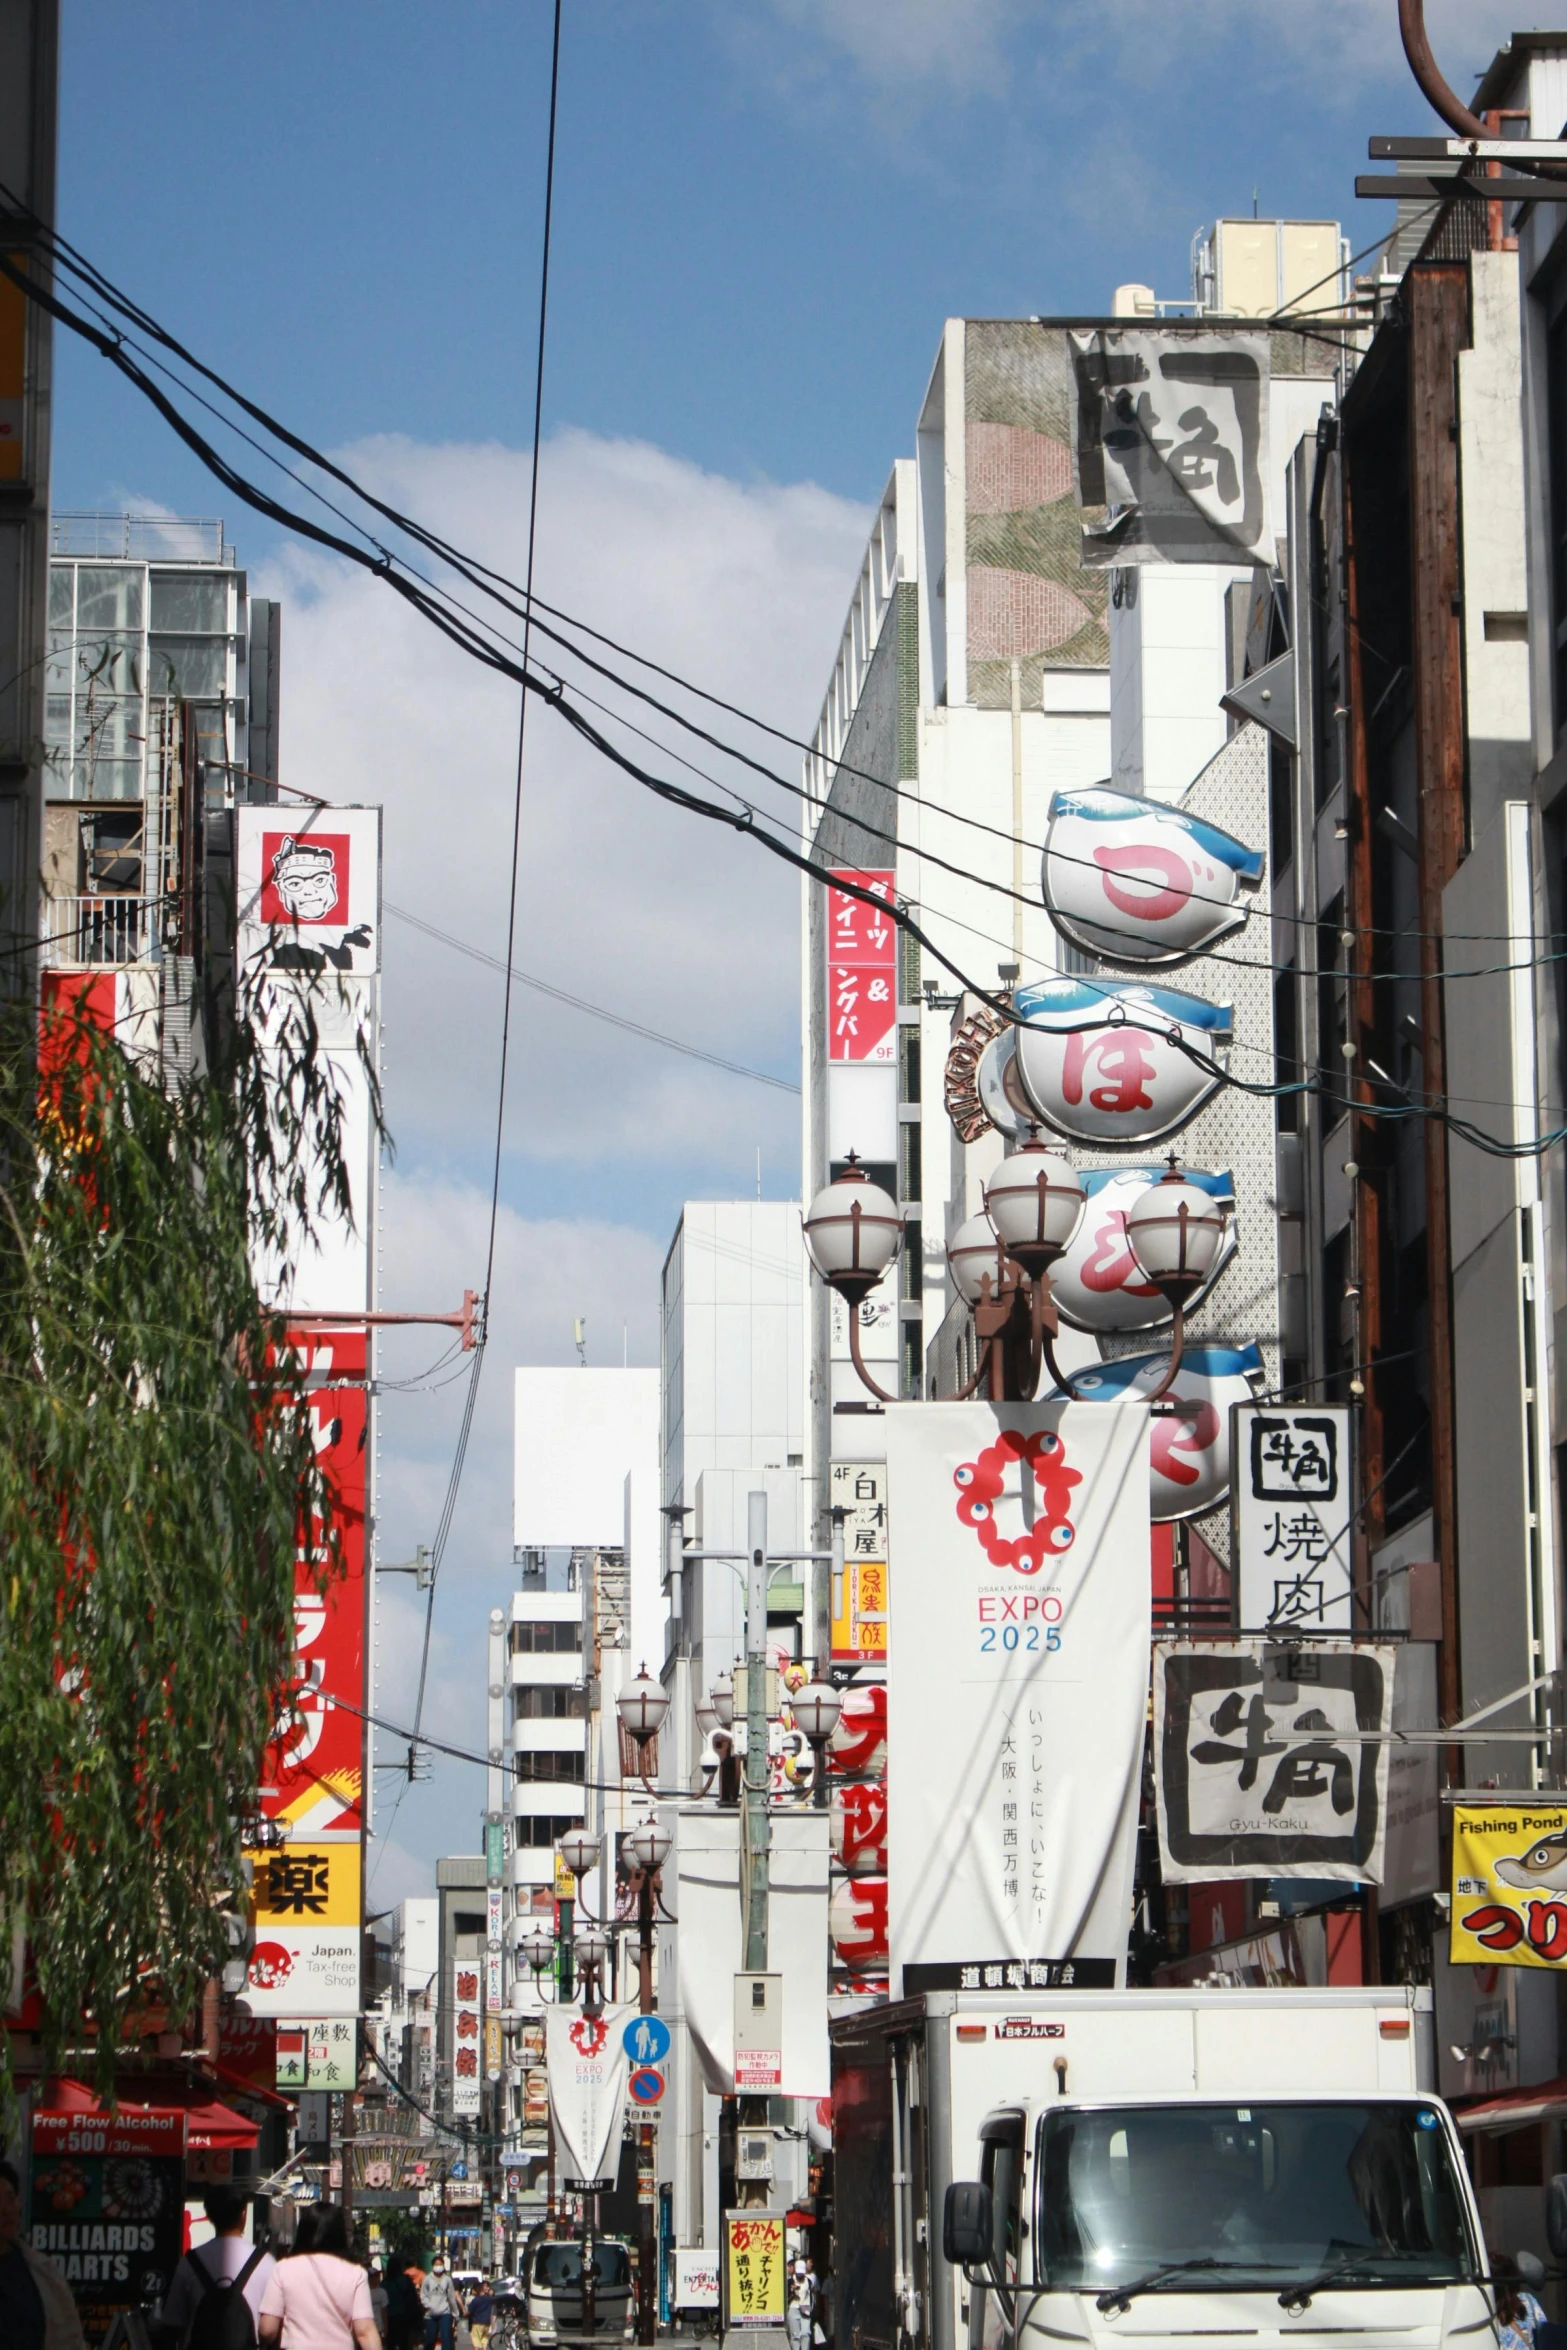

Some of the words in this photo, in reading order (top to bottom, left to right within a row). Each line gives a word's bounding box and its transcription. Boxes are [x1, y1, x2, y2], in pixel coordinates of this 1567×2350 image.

[867, 978, 890, 1002] &
[876, 1047, 894, 1059] 9F
[1263, 1432, 1329, 1483] 牛角
[833, 1467, 850, 1481] 4F
[1264, 1511, 1328, 1623] 焼肉
[978, 1595, 1063, 1623] EXPO
[980, 1625, 1062, 1652] 2025
[857, 1651, 875, 1660] 3F
[1190, 1691, 1355, 1817] 牛角
[1229, 1817, 1309, 1833] Gyu-Kaku
[1459, 1818, 1518, 1835] Fishing
[1522, 1816, 1563, 1830] Pond
[268, 1854, 329, 1915] 薬
[1457, 1878, 1487, 1894] 地下
[306, 1960, 356, 1972] Tax-free
[324, 1974, 356, 1988] Shop
[312, 2023, 351, 2042] 座敷
[1005, 2026, 1064, 2038] 日本フルハーフ
[575, 2065, 603, 2074] EXPO
[575, 2075, 602, 2084] 2025
[33, 2114, 68, 2129] Free
[72, 2114, 110, 2129] Flow
[115, 2115, 174, 2130] Alcohol
[630, 2109, 662, 2120] 自動車
[32, 2224, 156, 2252] BILLIARDS
[756, 2255, 773, 2311] チャリンコ
